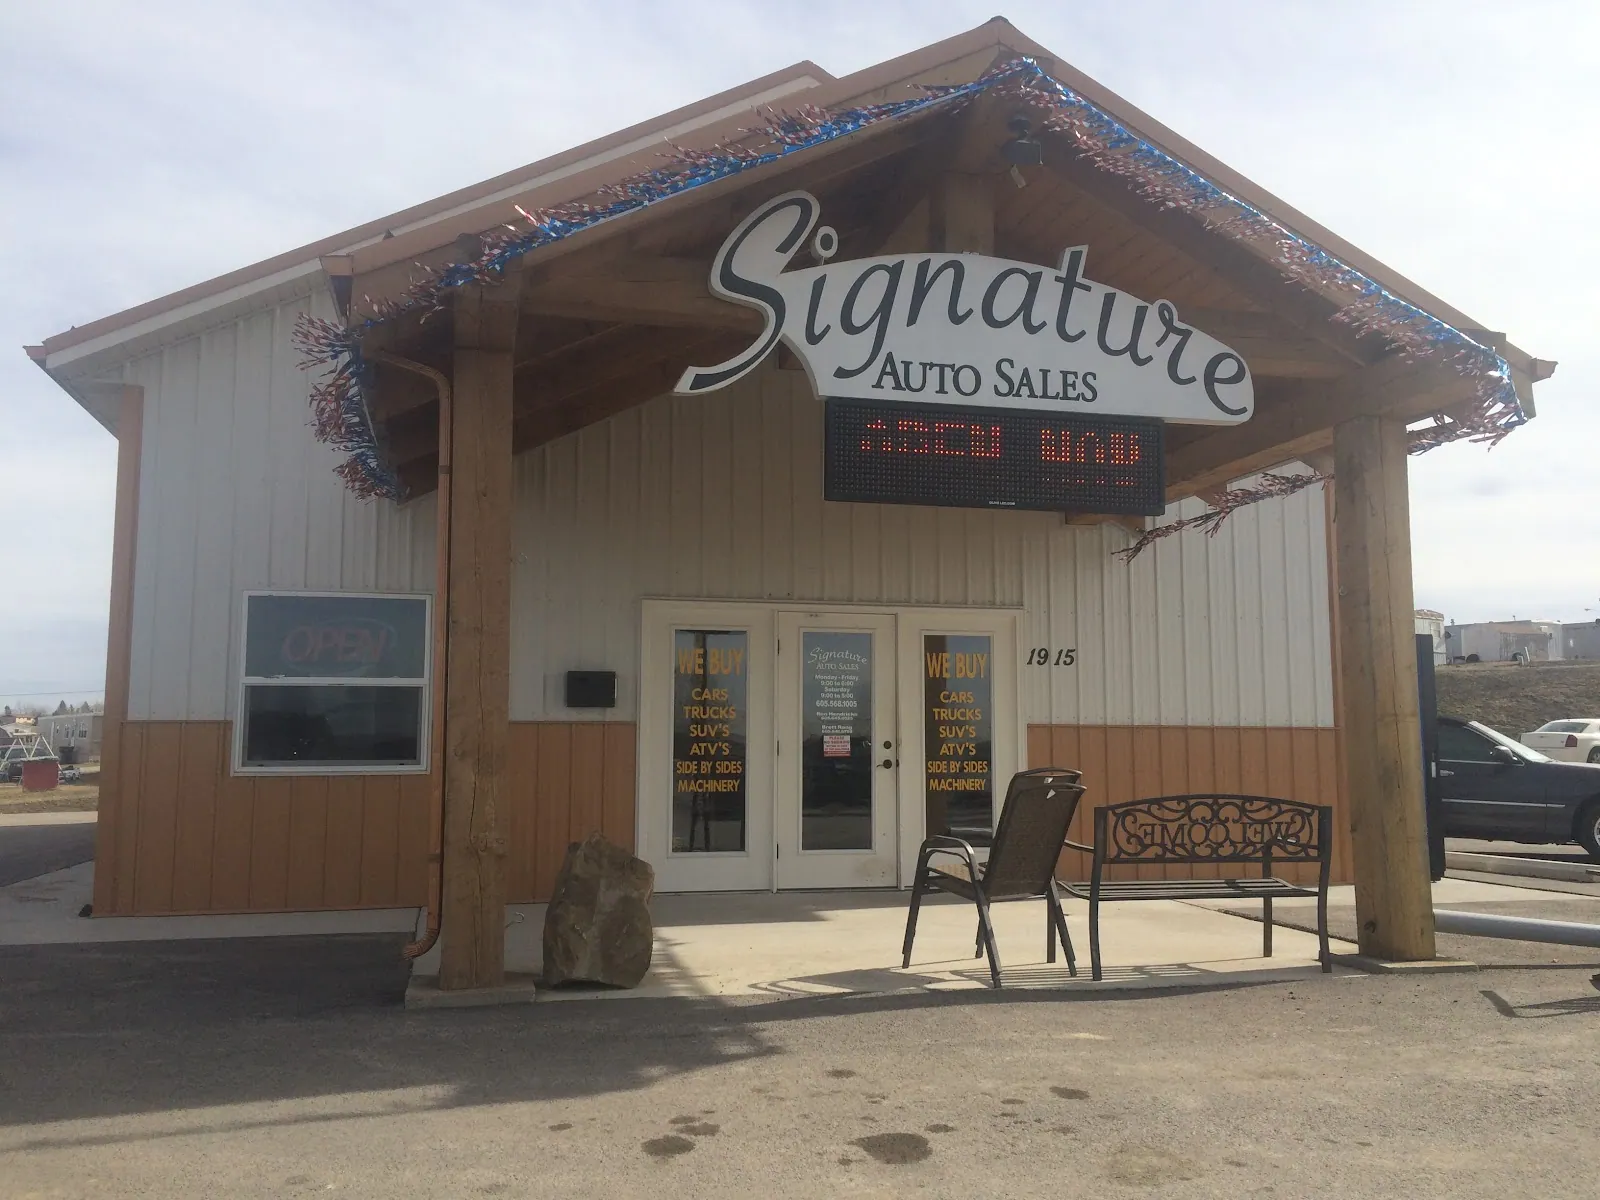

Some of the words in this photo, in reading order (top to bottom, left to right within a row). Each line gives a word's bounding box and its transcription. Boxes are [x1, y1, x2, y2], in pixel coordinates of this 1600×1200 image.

[690, 197, 1248, 416] Signature
[872, 351, 983, 397] AUTO
[993, 358, 1098, 403] SALES
[281, 625, 388, 663] OPEN
[678, 648, 704, 675] WE
[709, 648, 744, 676] BUY
[808, 647, 868, 664] Signature
[1026, 647, 1076, 666] 1915
[816, 662, 836, 670] AUTO
[838, 662, 859, 670] SALES
[926, 652, 951, 679] WE
[955, 652, 987, 679] BUY
[691, 688, 728, 701] CARS
[939, 691, 975, 703] CARS
[683, 706, 737, 719] TRUCKS
[932, 708, 982, 721] TRUCKS
[689, 724, 730, 737] SUV'S
[939, 725, 976, 738] SUV'S
[689, 742, 730, 756] ATV'S
[939, 743, 976, 756] ATV'S
[676, 761, 698, 774] SIDE
[701, 761, 712, 774] BY
[715, 761, 742, 774] SIDES
[927, 760, 947, 773] SIDE
[950, 761, 961, 773] BY
[963, 761, 988, 773] SIDES
[677, 779, 740, 793] MACHINERY
[929, 778, 986, 791] MACHINERY
